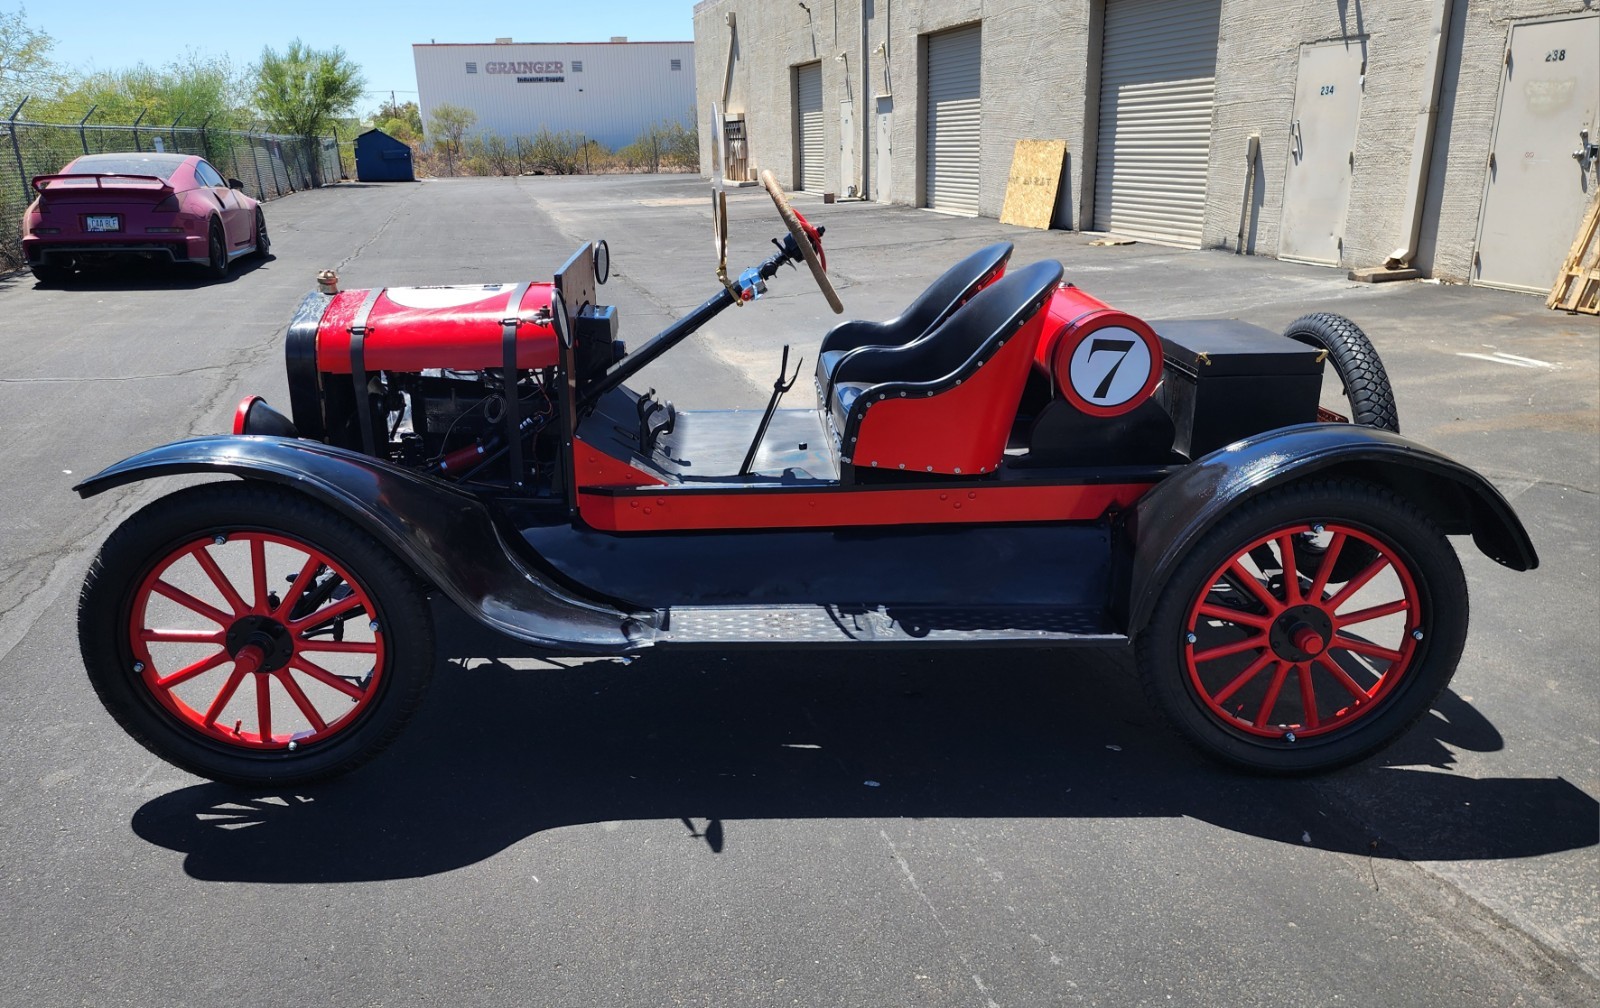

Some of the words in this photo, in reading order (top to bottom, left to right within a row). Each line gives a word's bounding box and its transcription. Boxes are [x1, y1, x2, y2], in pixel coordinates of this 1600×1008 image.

[1545, 49, 1566, 62] 238
[485, 61, 564, 74] GRAINGER
[1320, 85, 1334, 96] 234
[1087, 339, 1135, 398] 7
